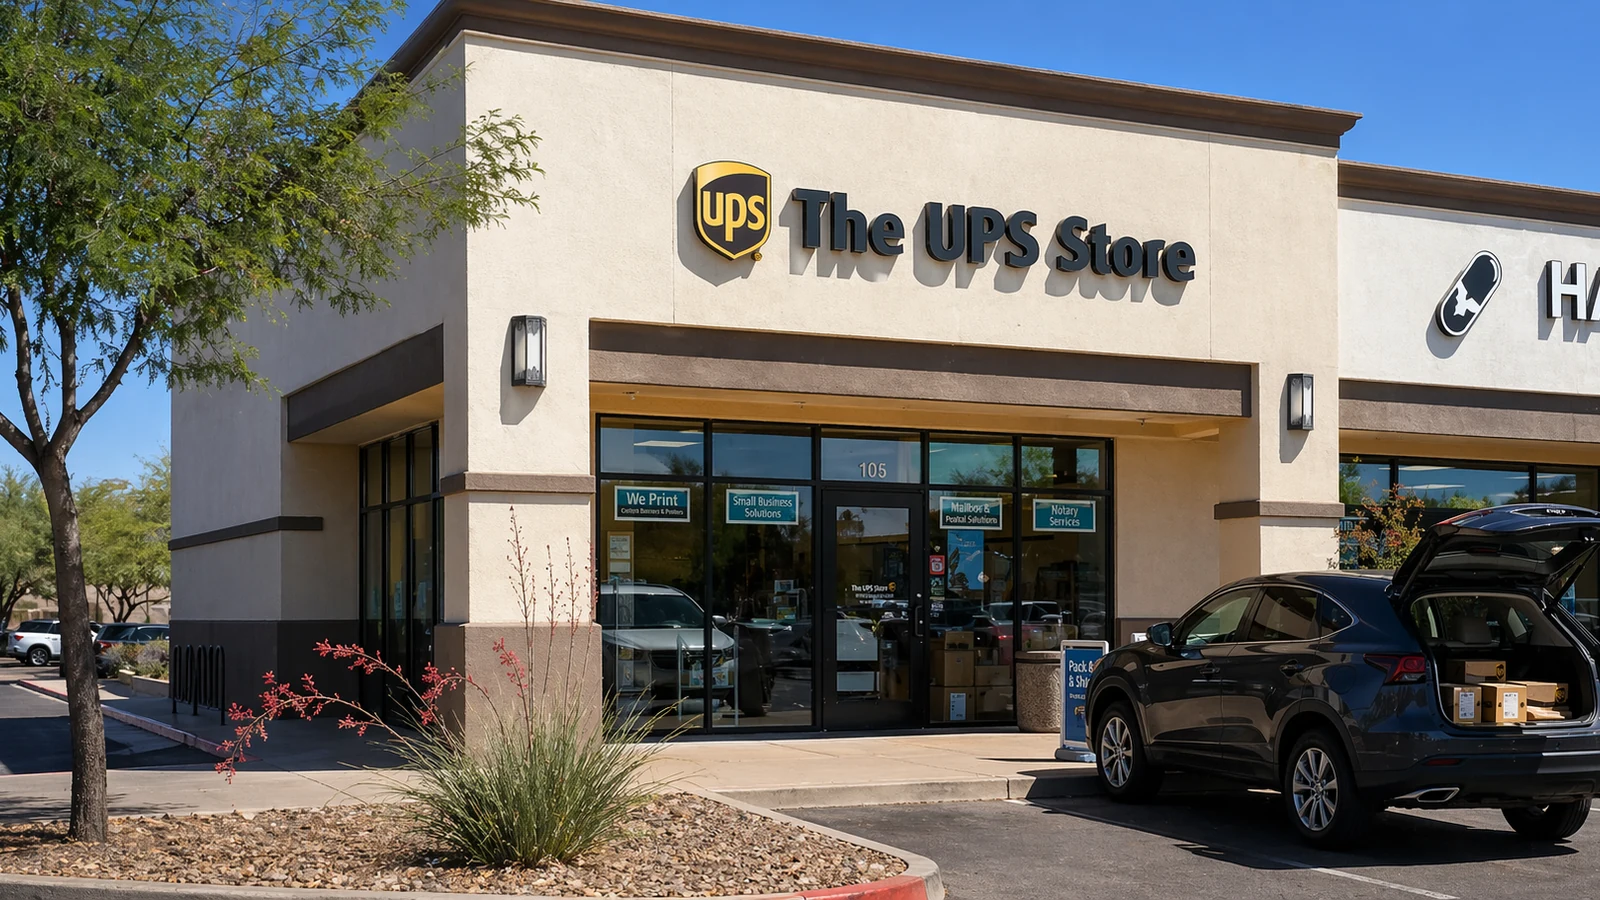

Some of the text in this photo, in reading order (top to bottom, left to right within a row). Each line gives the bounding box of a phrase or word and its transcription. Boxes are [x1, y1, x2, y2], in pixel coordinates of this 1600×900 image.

[702, 190, 766, 242] ups
[792, 187, 1196, 282] The UPS Store
[859, 462, 887, 479] 105
[626, 491, 678, 506] We Print
[733, 495, 793, 507] Small Business
[744, 507, 782, 519] Solutions
[984, 503, 990, 513] &
[1051, 504, 1078, 518] Notary
[1049, 516, 1080, 527] Services
[1068, 659, 1087, 673] Pack
[1068, 674, 1075, 688] &
